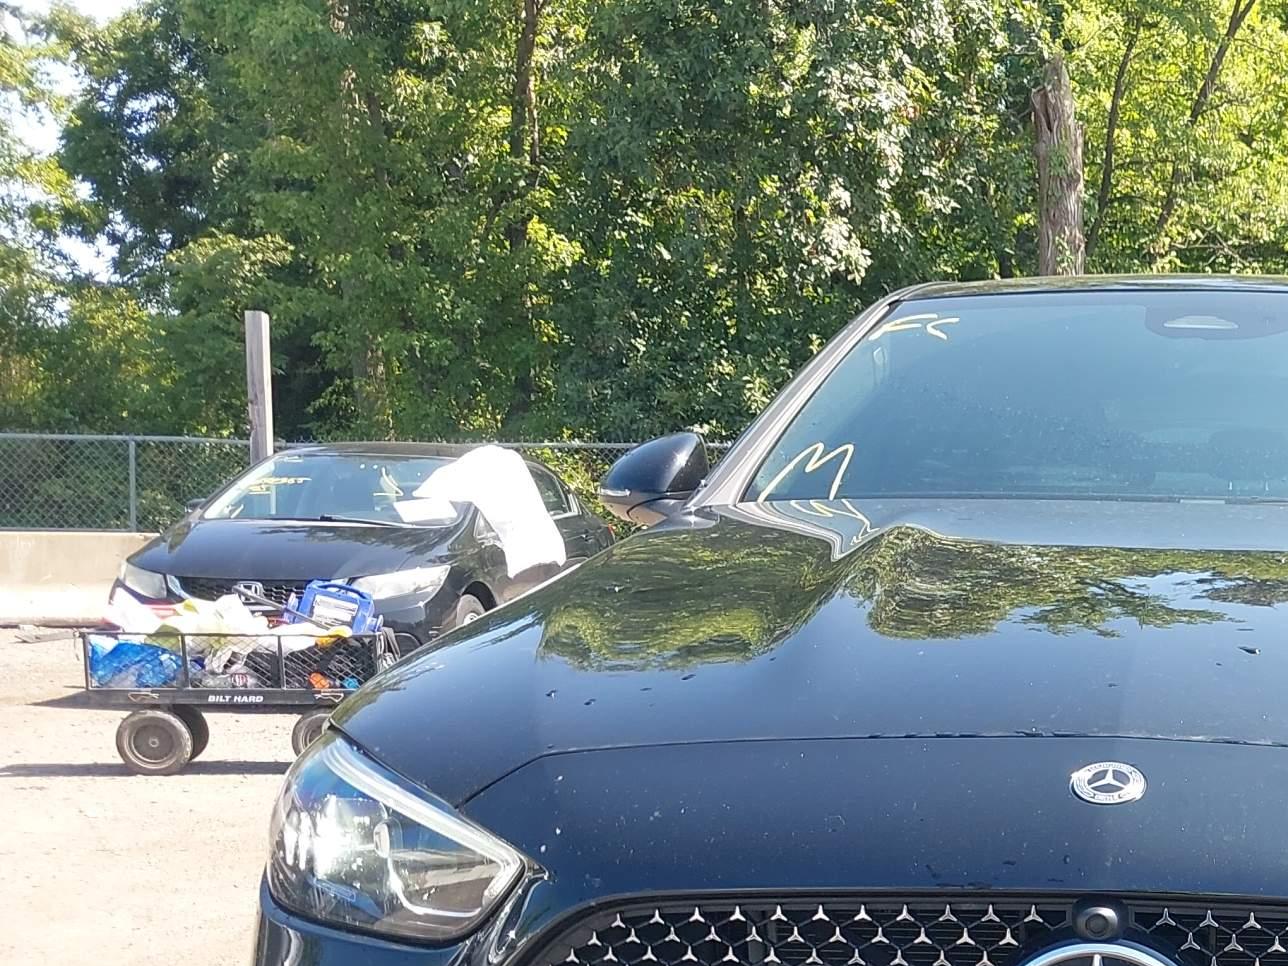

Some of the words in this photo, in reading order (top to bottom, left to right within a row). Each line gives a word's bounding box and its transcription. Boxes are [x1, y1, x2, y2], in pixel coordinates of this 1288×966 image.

[757, 441, 856, 503] M
[207, 695, 232, 703] BILT
[233, 695, 264, 703] HARD
